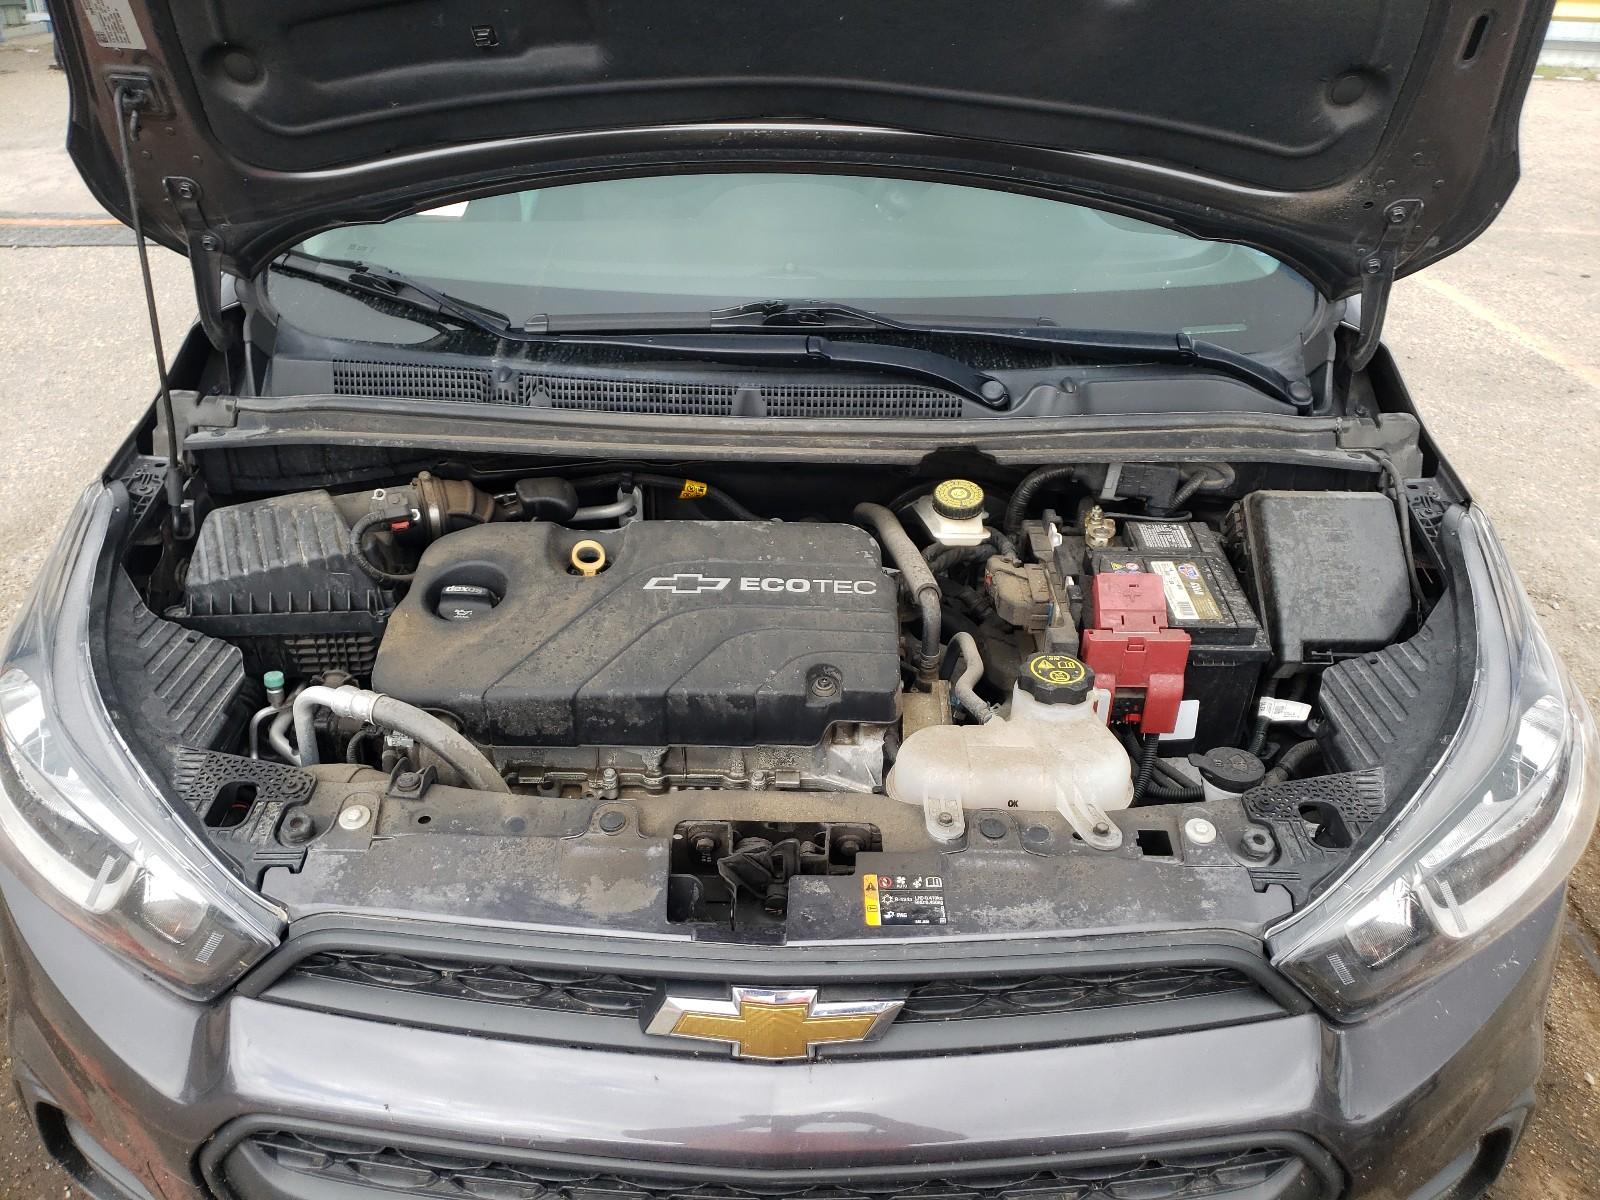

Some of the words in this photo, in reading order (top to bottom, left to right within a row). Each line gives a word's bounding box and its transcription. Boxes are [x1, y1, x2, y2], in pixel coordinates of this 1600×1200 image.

[445, 585, 482, 594] dexos
[740, 577, 877, 595] ECOTEC
[1007, 799, 1019, 808] OK
